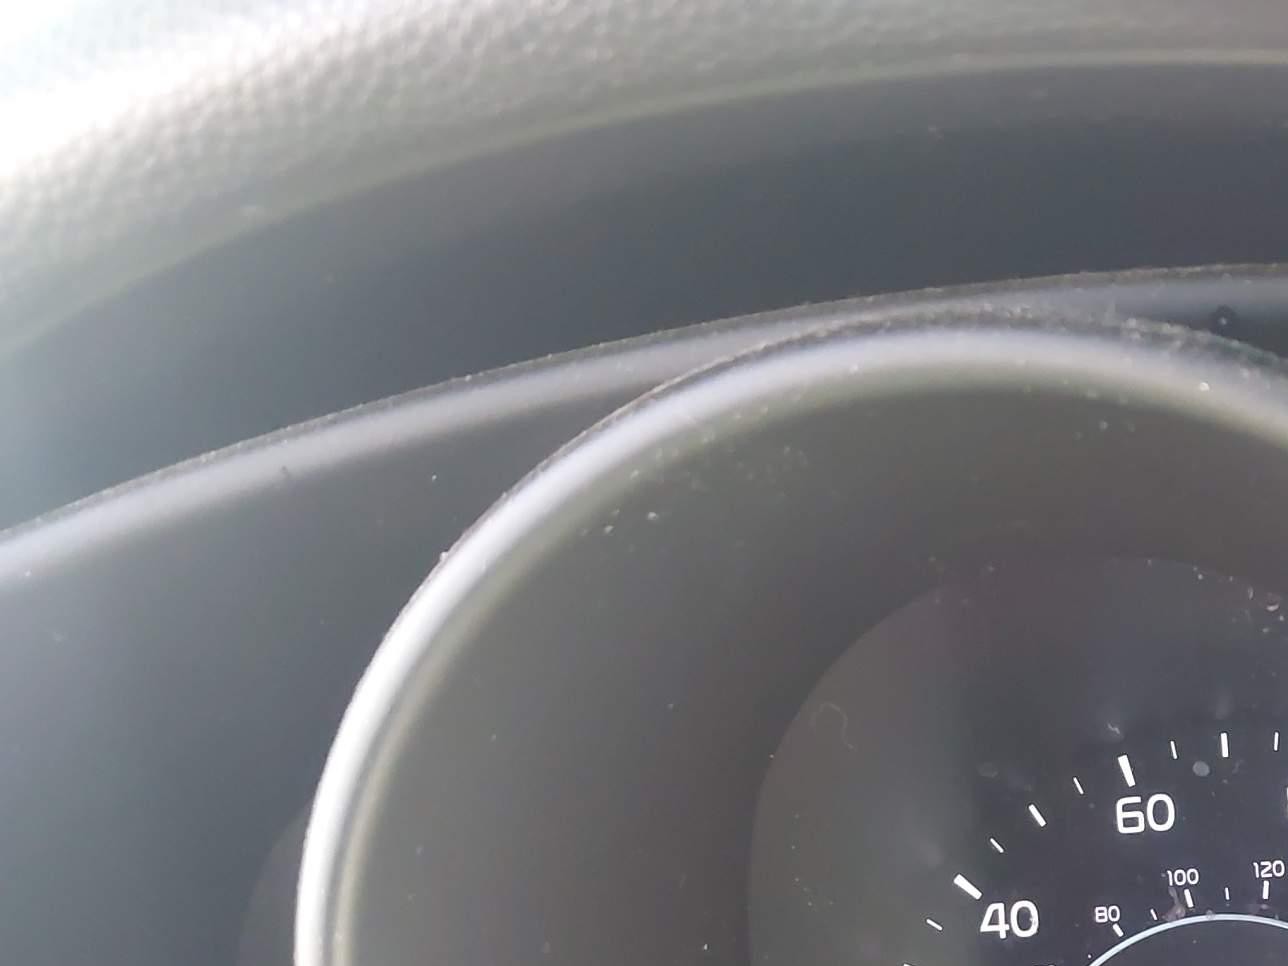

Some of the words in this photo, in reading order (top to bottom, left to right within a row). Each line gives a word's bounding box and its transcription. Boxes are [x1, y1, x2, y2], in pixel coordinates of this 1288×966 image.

[1116, 793, 1175, 834] 60
[1166, 868, 1199, 887] 100
[1253, 860, 1285, 879] 120
[979, 900, 1040, 939] 40
[1094, 905, 1121, 922] 80
